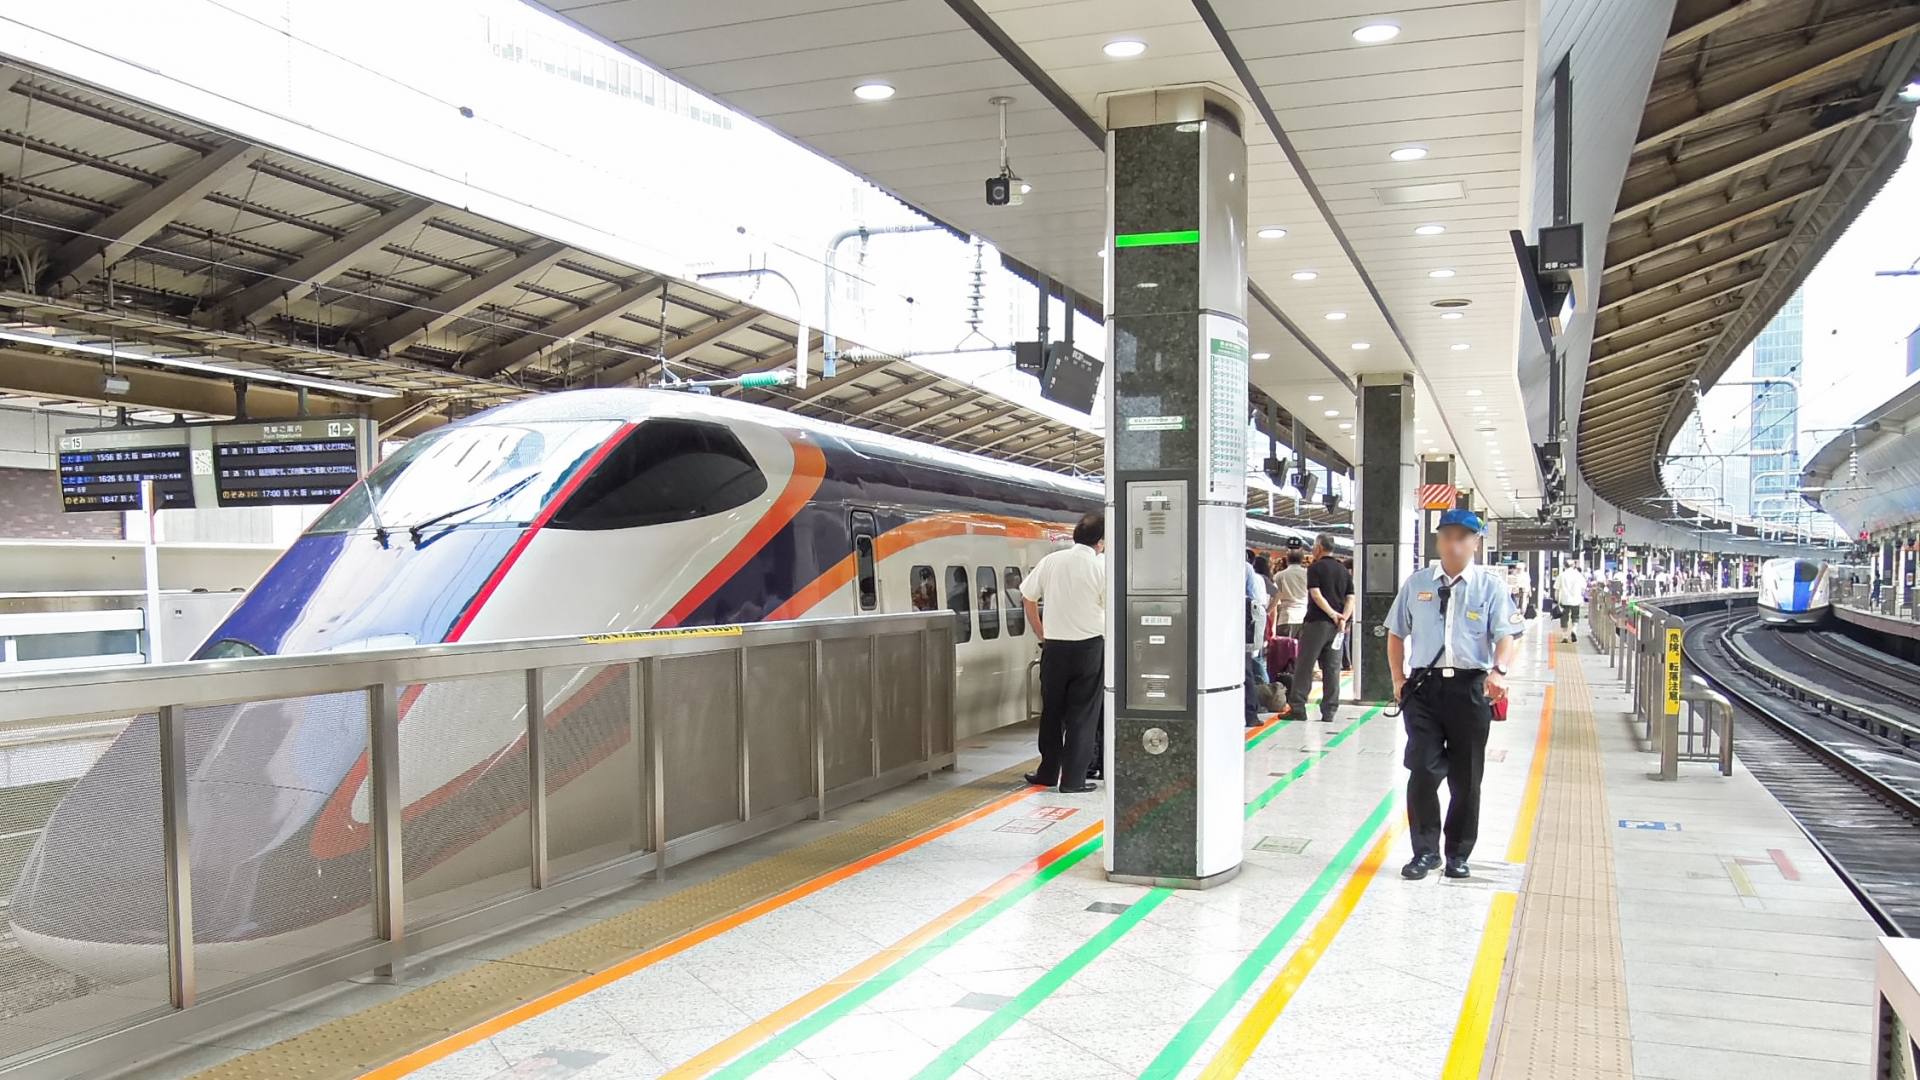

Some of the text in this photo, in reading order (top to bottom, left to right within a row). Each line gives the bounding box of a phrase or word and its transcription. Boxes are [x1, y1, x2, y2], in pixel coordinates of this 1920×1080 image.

[330, 424, 339, 435] 14
[72, 438, 80, 448] 15
[222, 491, 245, 499] のぞみ
